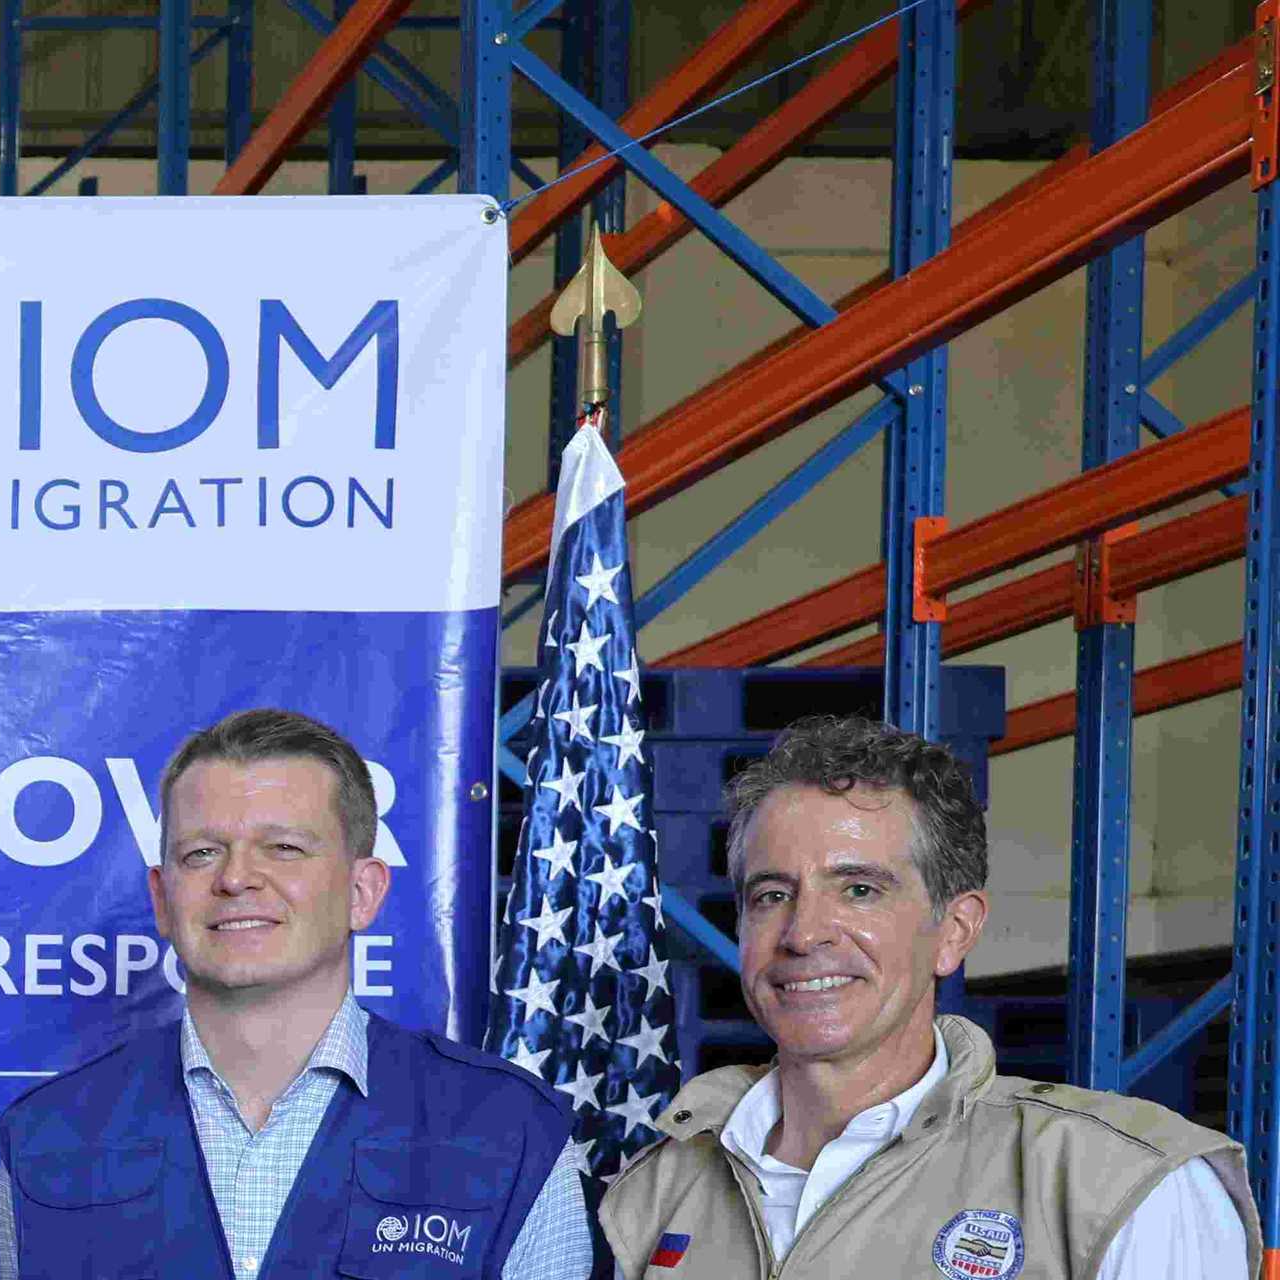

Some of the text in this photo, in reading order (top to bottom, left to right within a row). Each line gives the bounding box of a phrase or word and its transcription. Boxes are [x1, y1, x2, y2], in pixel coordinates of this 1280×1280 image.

[19, 298, 399, 453] IOM
[414, 1213, 471, 1252] IOM
[969, 1224, 1009, 1241] USAID
[372, 1242, 464, 1265] UN MIGRATION
